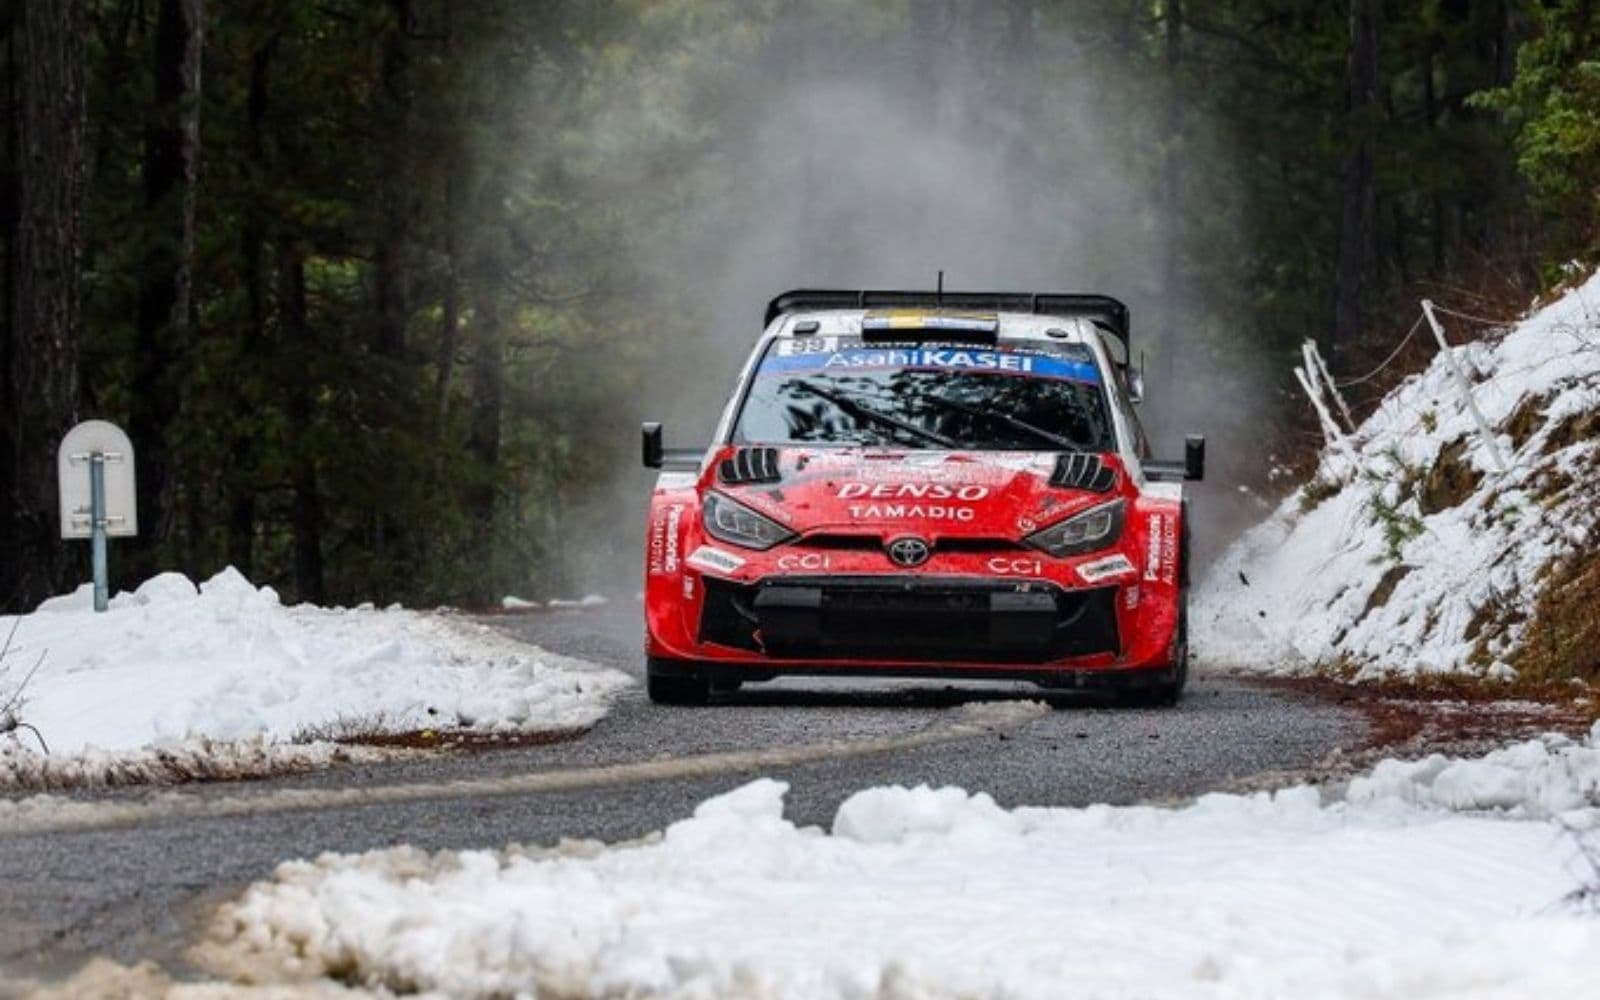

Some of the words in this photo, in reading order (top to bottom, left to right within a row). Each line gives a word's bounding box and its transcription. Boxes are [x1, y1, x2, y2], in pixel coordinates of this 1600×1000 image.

[837, 483, 988, 500] DENSO
[850, 505, 975, 520] TAMADIC
[1143, 513, 1161, 581] Panasonic
